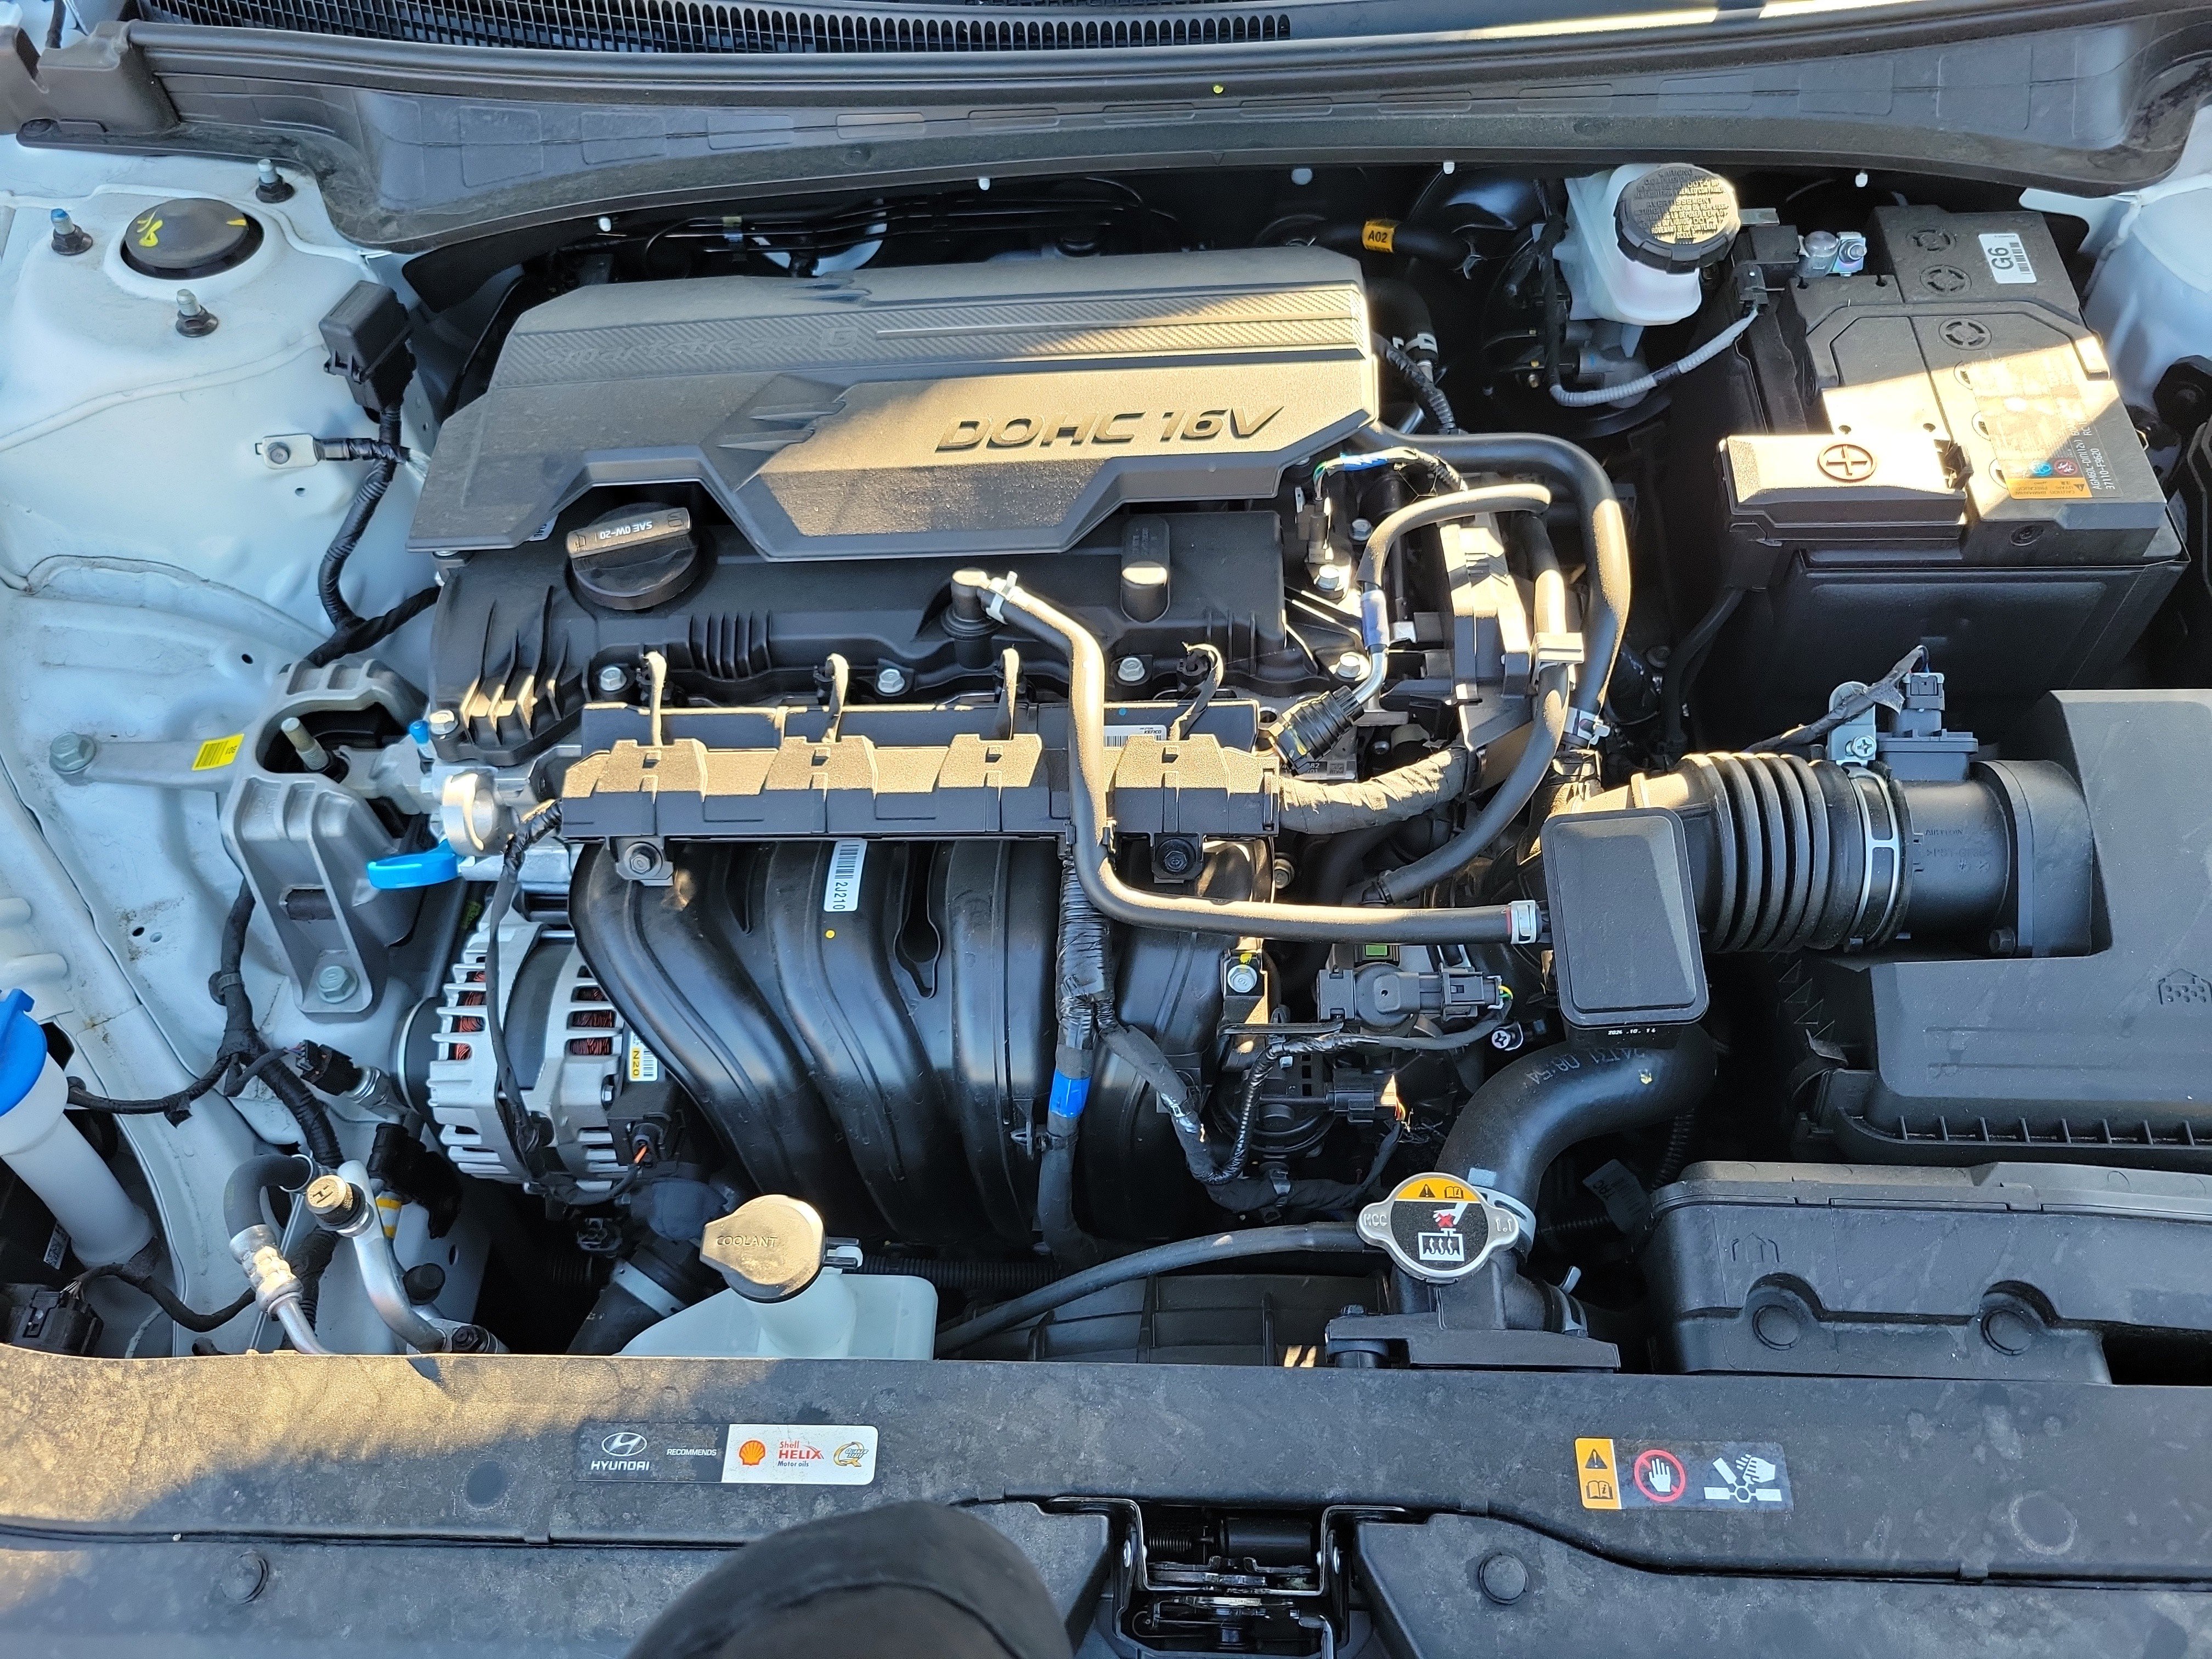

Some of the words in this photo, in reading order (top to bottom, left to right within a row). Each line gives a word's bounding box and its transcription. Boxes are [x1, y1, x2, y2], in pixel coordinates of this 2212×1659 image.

[1368, 230, 1387, 243] A02
[1988, 247, 2014, 270] G6
[934, 411, 1146, 453] DOHC
[1161, 405, 1285, 442] 16V
[600, 524, 631, 539] 0W-20
[632, 521, 653, 531] SAE
[833, 882, 848, 910] 2J210
[1496, 1218, 1513, 1232] 1.1
[715, 1234, 777, 1249] COOLANT
[666, 1447, 717, 1457] RECOMMENDS
[778, 1449, 823, 1459] HELIX
[590, 1460, 650, 1471] HYUNDAI
